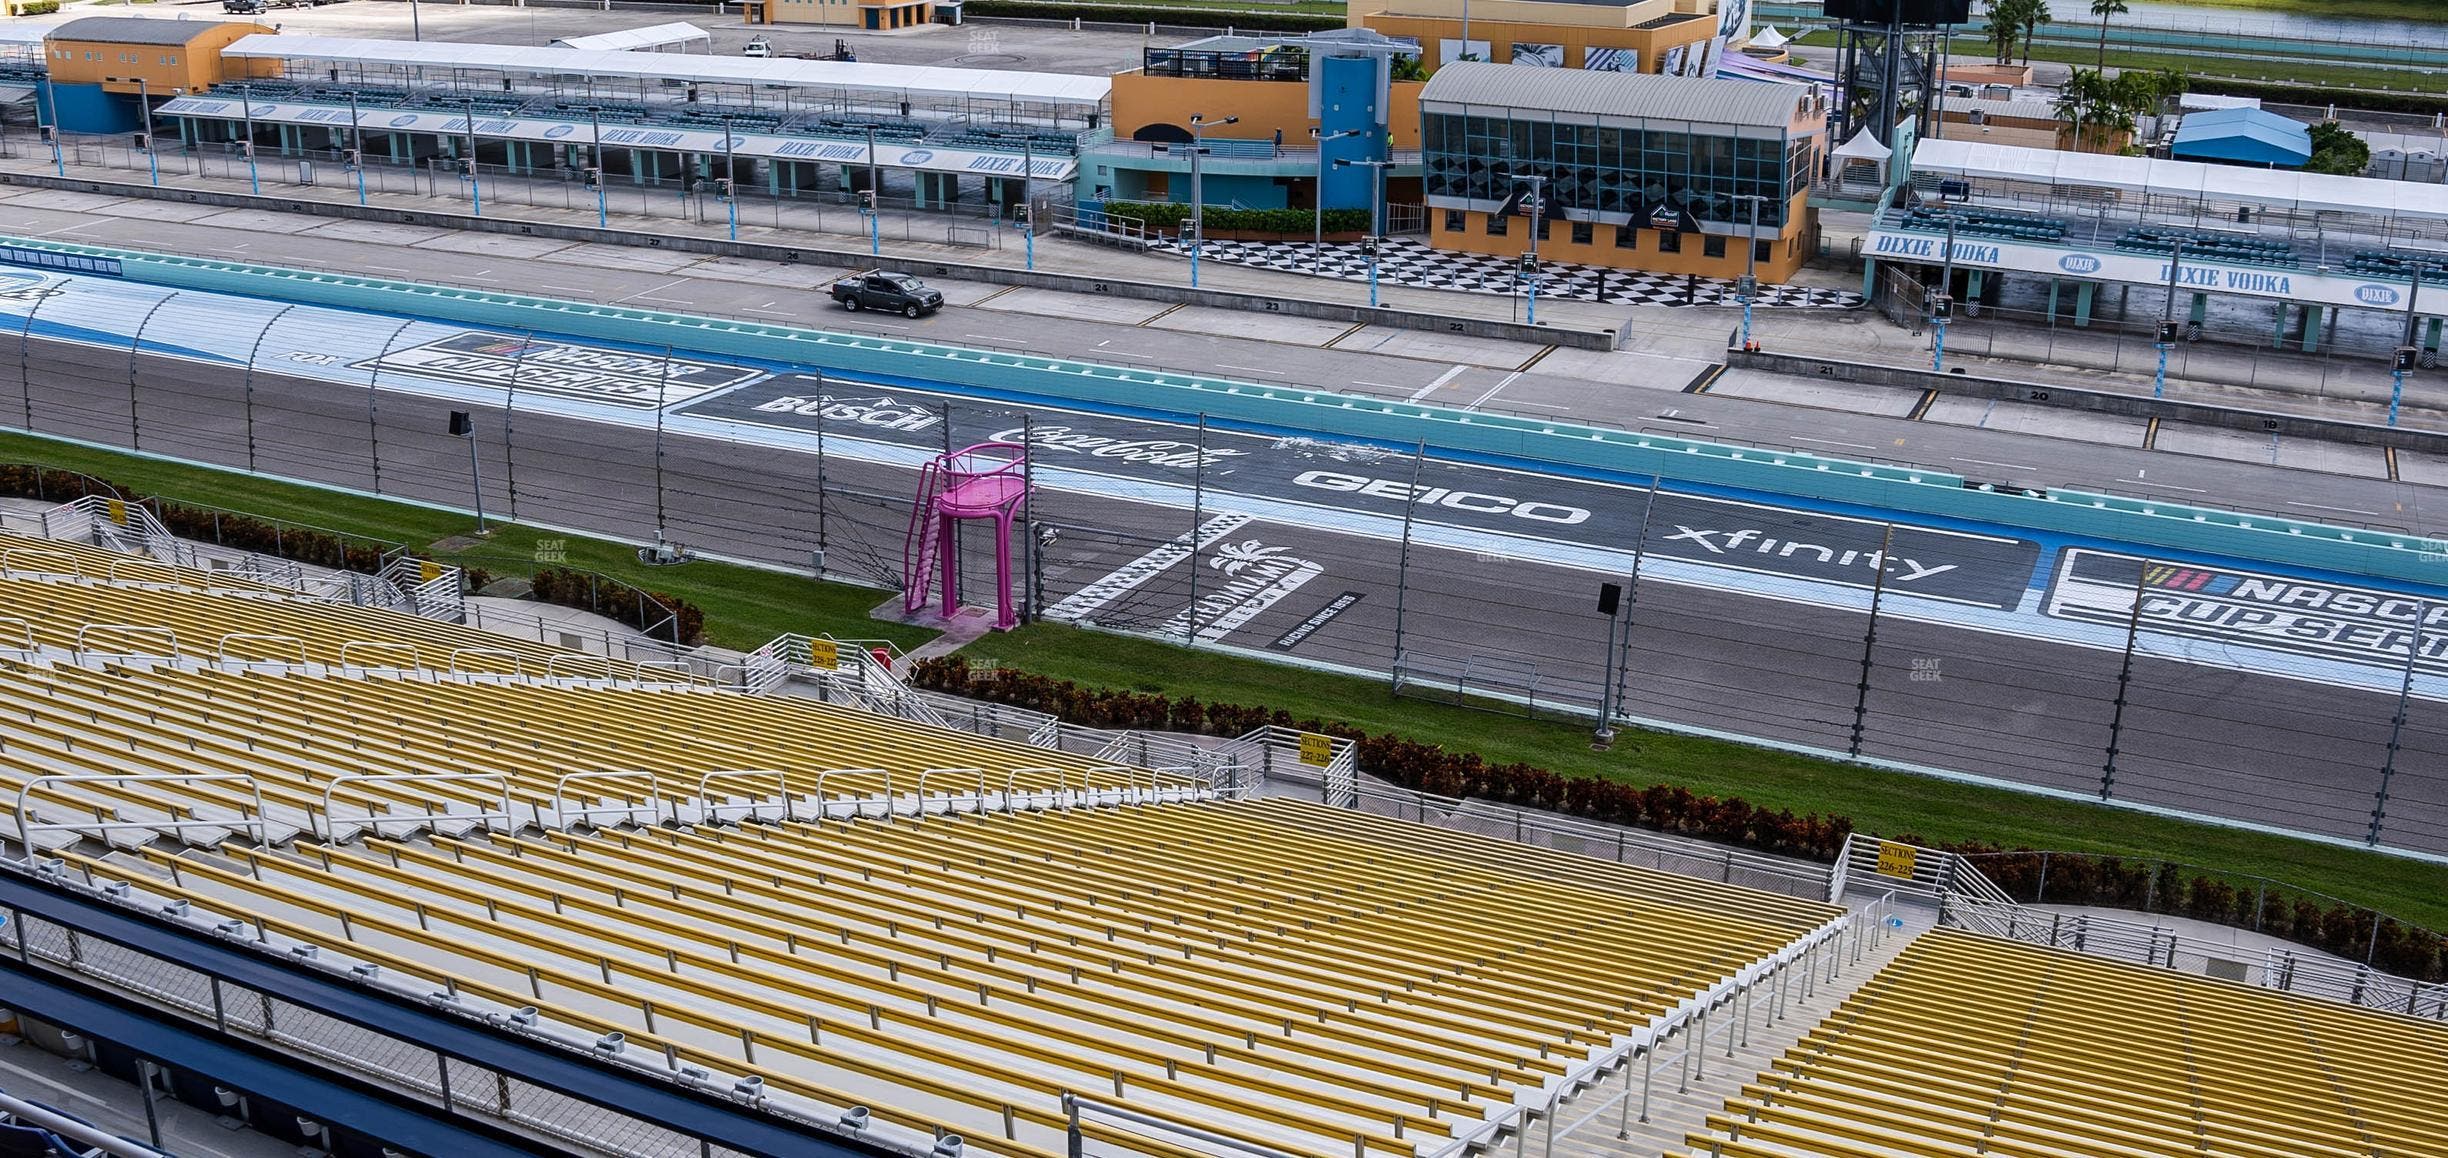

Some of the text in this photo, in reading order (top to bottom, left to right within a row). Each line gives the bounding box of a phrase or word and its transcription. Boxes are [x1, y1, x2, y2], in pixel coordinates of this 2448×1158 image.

[776, 141, 821, 156] DIXIE
[968, 155, 1017, 171] DIXIE
[649, 238, 660, 246] 27
[1875, 235, 2000, 264] DIXIE VODKA
[787, 252, 799, 260] 26
[935, 267, 948, 275] 25
[2065, 256, 2095, 272] DIXIE
[2160, 263, 2291, 295] DIXIE VODKA
[1095, 284, 1108, 292] 24
[2361, 286, 2393, 303] DIXIE
[1265, 302, 1279, 311] 23
[1450, 322, 1464, 332] 22
[1820, 366, 1834, 375] 21
[2031, 391, 2049, 401] 20
[751, 395, 944, 432] BUSCH
[1292, 470, 1592, 525] GEICO
[1662, 524, 1958, 581] xfinity
[2129, 595, 2279, 629] CUP
[1278, 623, 1315, 647] RACING
[1308, 607, 1338, 626] SINCE
[1301, 736, 1330, 750] SECTIONS
[1301, 750, 1330, 763] 227-226
[1880, 845, 1915, 860] SECTIONS
[1879, 861, 1913, 876] 226-225
